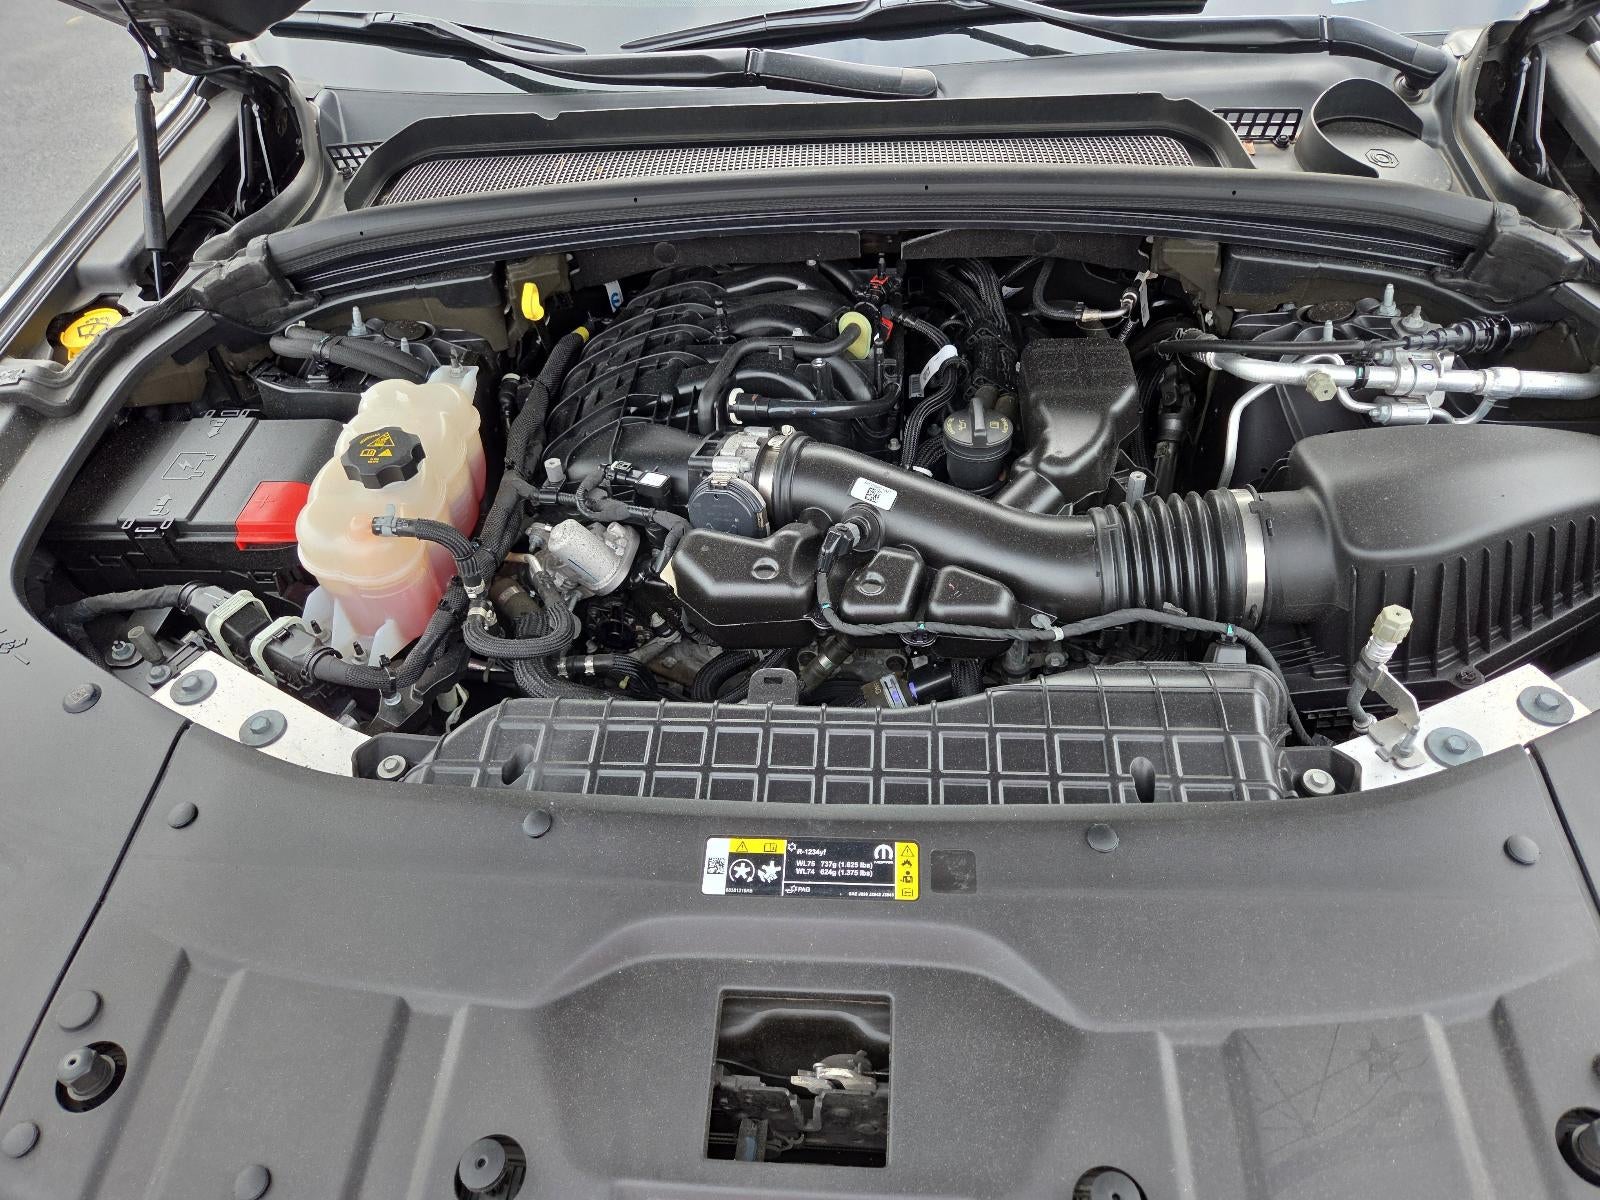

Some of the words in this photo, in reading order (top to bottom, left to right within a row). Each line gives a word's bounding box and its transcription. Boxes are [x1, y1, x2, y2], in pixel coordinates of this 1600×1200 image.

[796, 848, 827, 857] R-1234yf
[820, 861, 837, 869] 737g
[860, 862, 873, 870] lbs)
[795, 867, 816, 875] WL74
[820, 869, 837, 877] 624g
[838, 869, 859, 877] (1.375
[860, 870, 873, 878] lbs)
